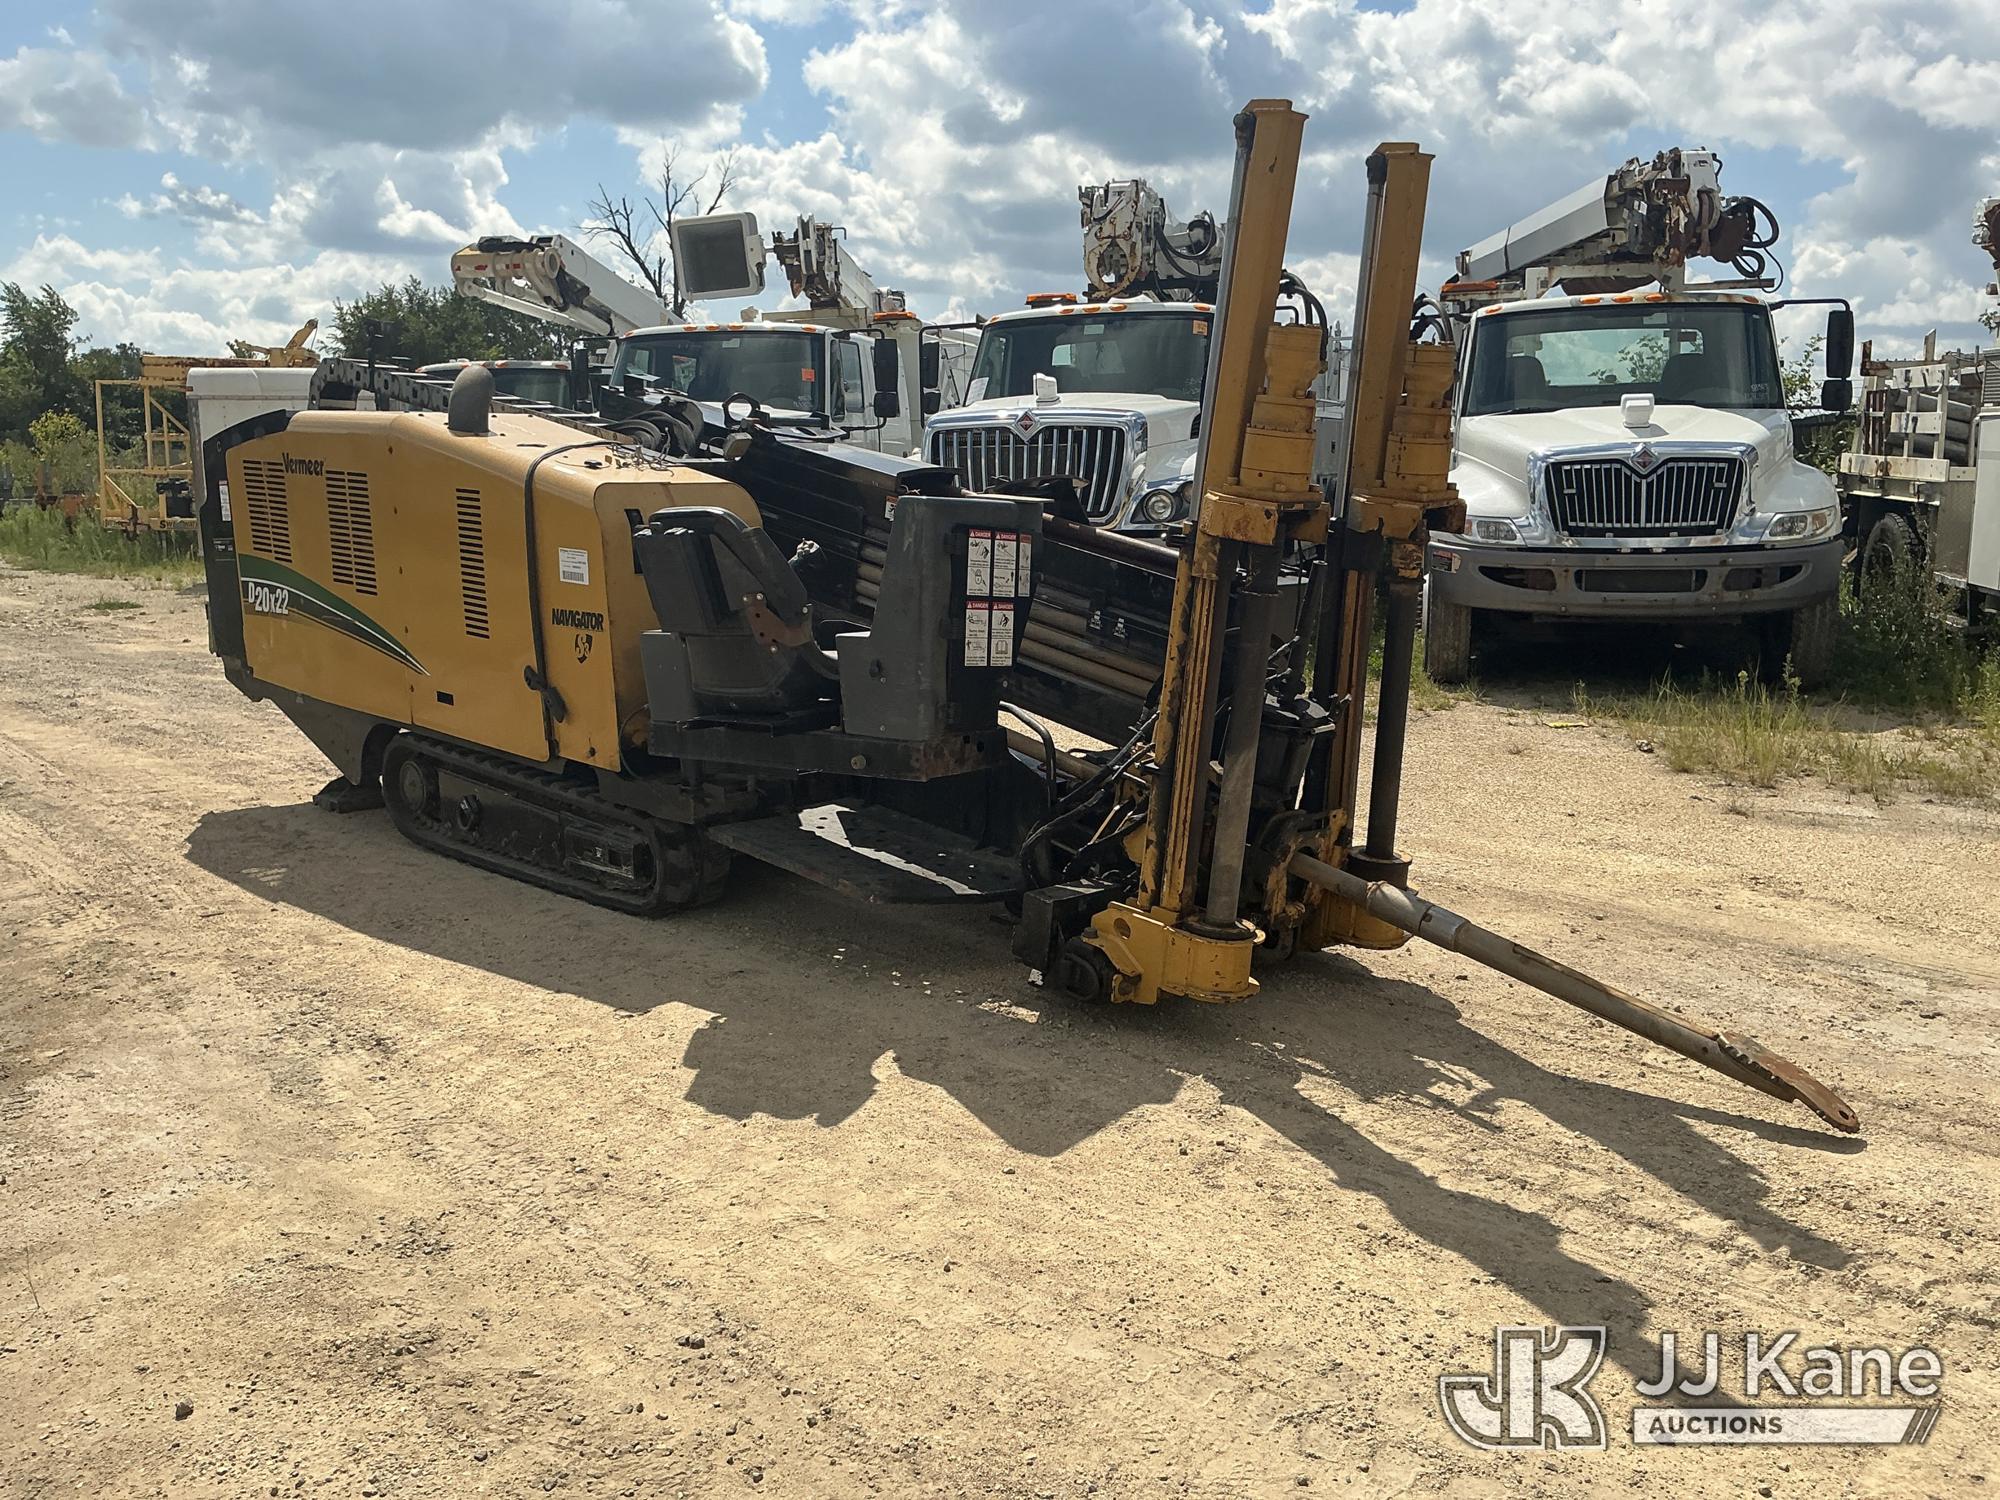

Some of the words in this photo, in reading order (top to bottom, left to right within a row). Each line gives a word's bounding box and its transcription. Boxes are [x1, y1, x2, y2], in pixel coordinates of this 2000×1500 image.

[282, 452, 324, 476] Vermeer
[248, 582, 289, 615] D20x22
[552, 608, 604, 632] NAVIGATOR
